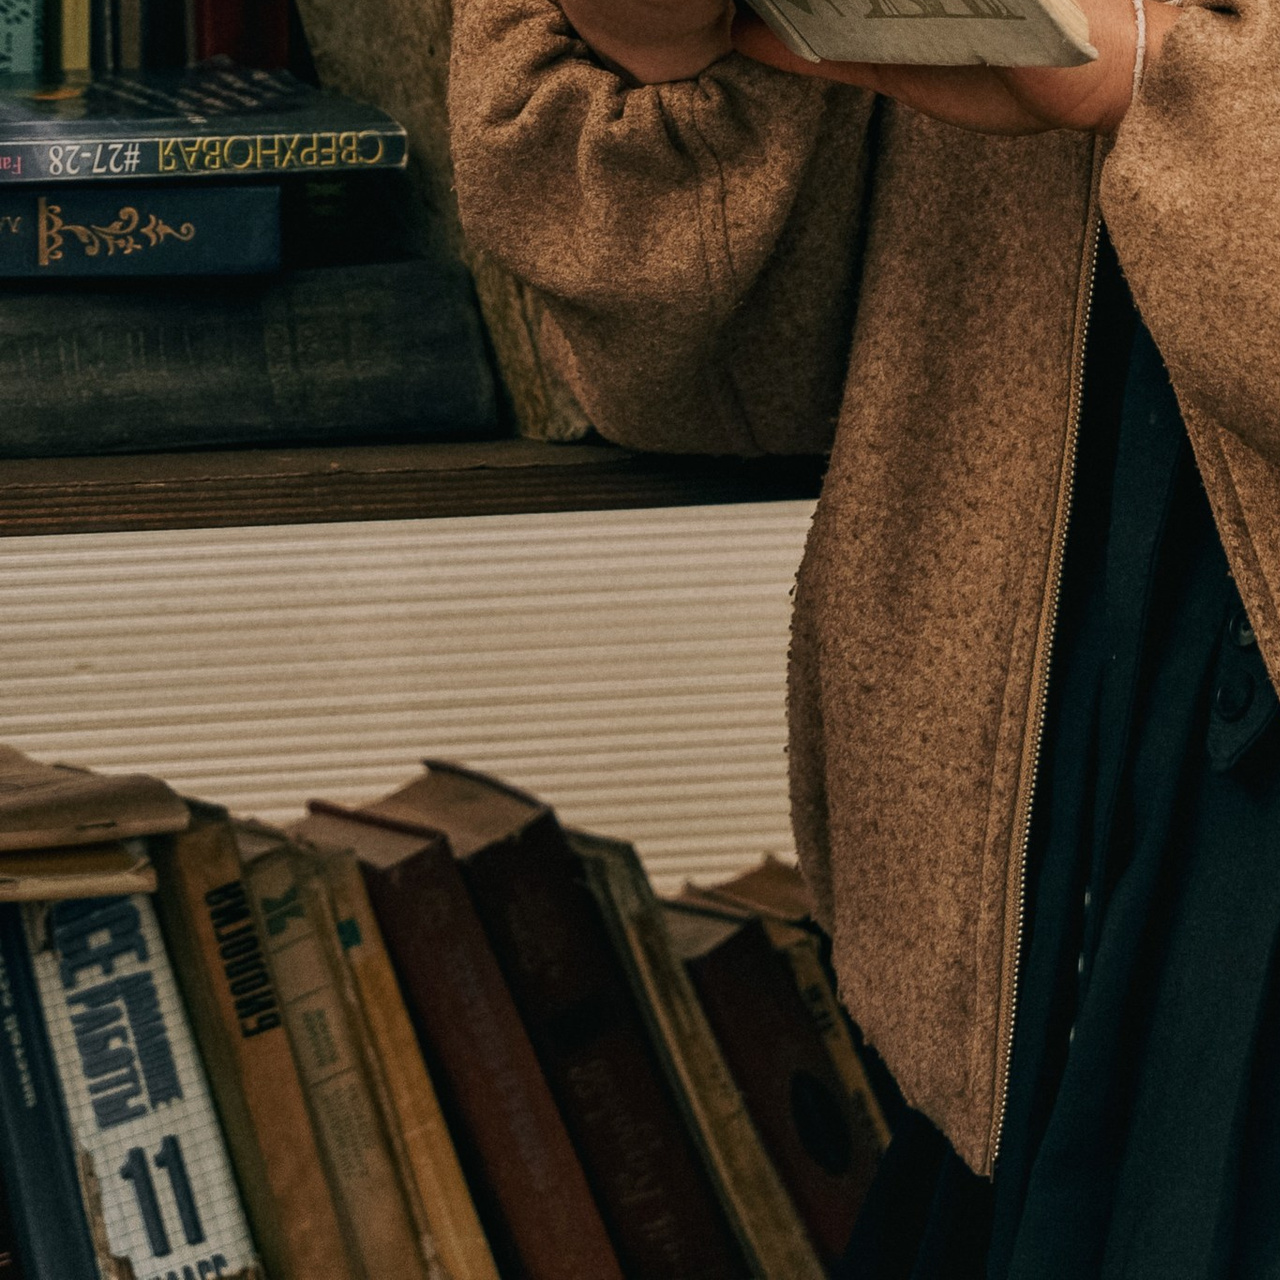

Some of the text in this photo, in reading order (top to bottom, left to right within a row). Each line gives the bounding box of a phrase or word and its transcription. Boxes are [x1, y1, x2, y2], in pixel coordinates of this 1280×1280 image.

[48, 132, 384, 176] СВЕРХНОВАЯ #27-28
[205, 881, 281, 1038] БИОЛОГИЯ
[119, 1134, 207, 1258] 11
